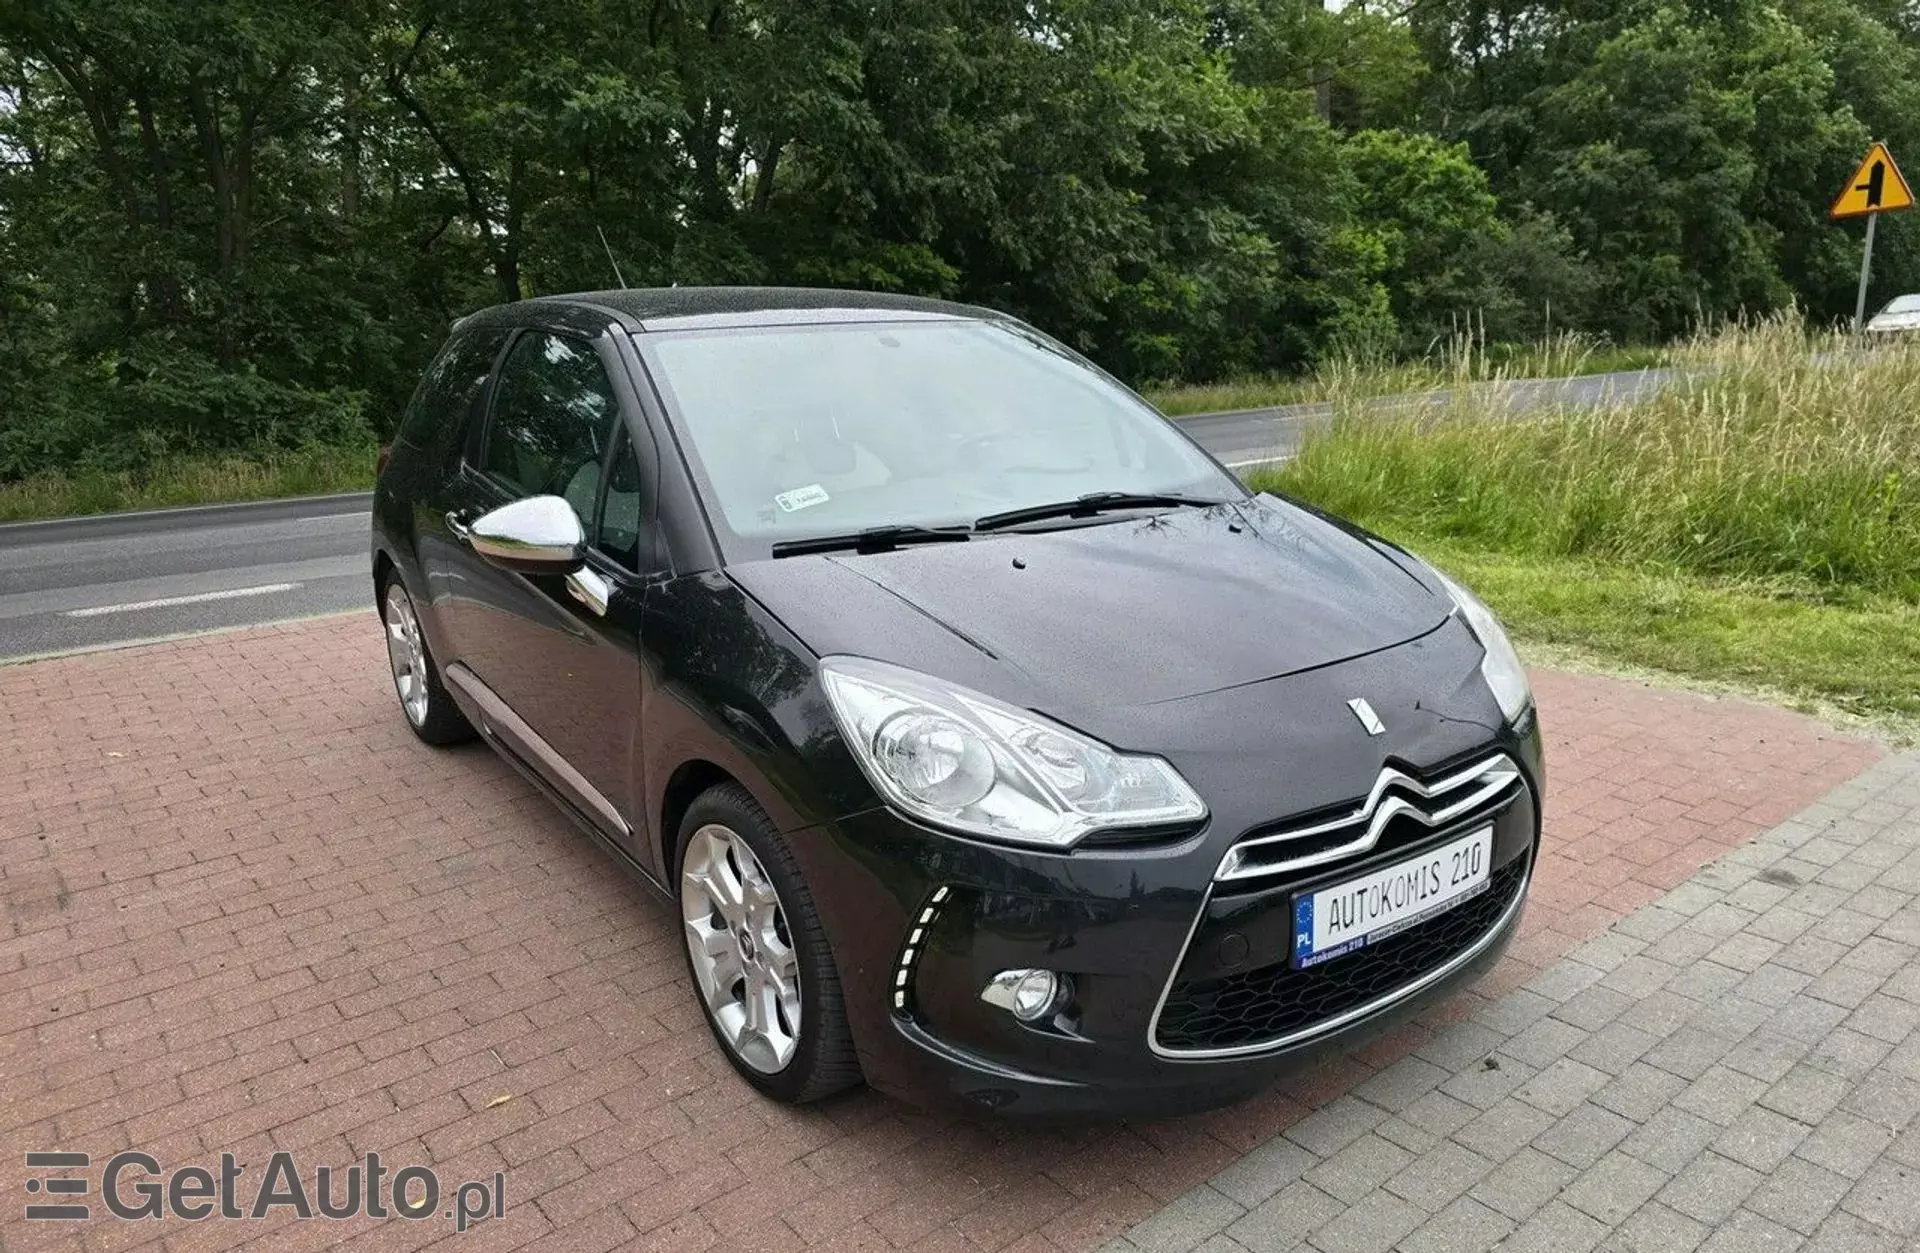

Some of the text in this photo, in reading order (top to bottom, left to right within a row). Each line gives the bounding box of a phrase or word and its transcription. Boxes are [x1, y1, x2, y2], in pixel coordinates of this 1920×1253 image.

[1328, 860, 1440, 935] AUTOKOMIS
[1451, 841, 1481, 887] 210
[1296, 932, 1311, 948] PL
[1301, 944, 1348, 968] Autokomis
